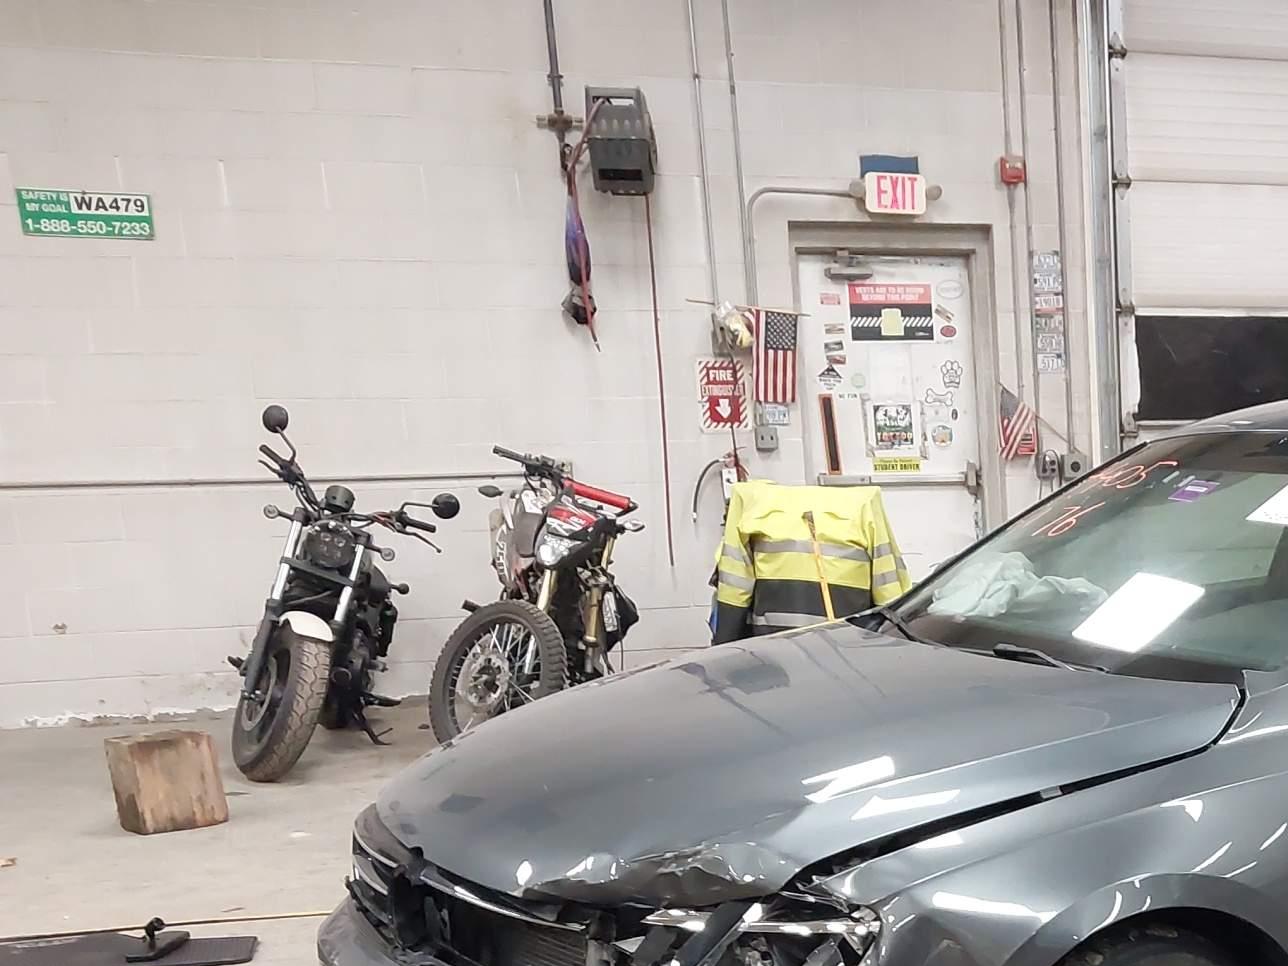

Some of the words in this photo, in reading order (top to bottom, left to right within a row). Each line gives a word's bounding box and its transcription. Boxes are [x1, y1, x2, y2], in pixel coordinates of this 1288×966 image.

[21, 191, 58, 201] SAFETY
[59, 192, 69, 202] IS
[876, 175, 918, 210] EXIT
[41, 203, 69, 213] GOAL
[73, 195, 145, 213] WA479
[25, 218, 150, 236] 1-888-550-7233
[709, 369, 734, 381] FIRE
[874, 463, 898, 471] STUDENT
[899, 463, 920, 471] DRIVER
